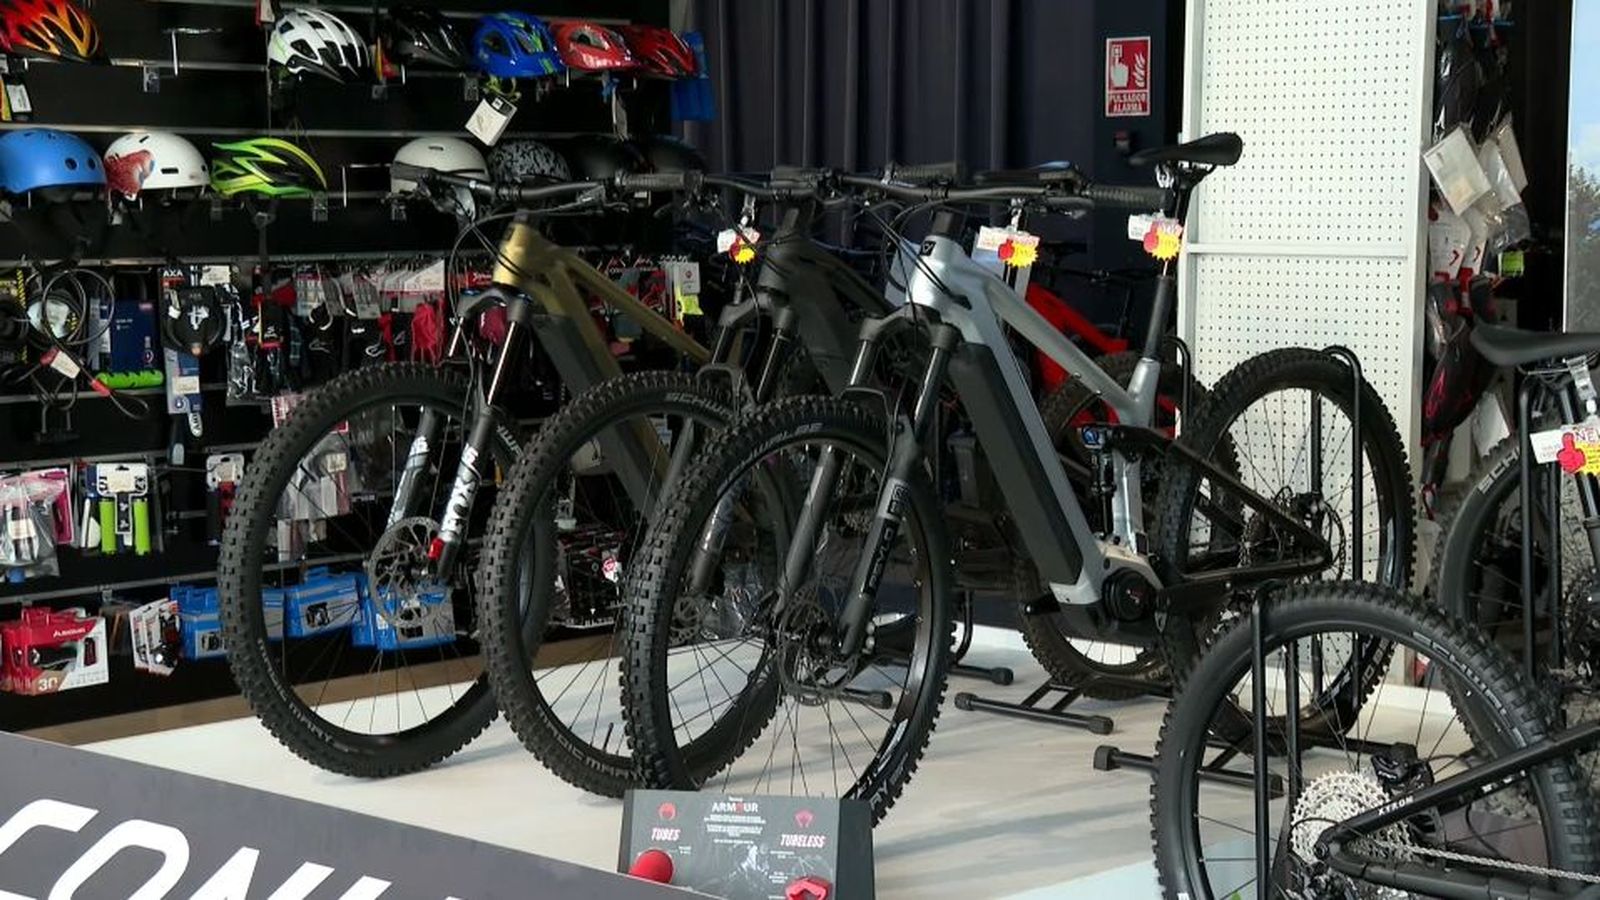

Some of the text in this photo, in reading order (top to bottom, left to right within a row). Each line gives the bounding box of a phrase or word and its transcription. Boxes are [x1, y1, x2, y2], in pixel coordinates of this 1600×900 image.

[1109, 93, 1146, 103] PULSADOR
[1113, 103, 1142, 111] ALARMA
[1477, 446, 1520, 494] SCH
[38, 676, 58, 691] 30
[712, 802, 758, 813] ARMOUR
[651, 827, 681, 842] TUBES
[780, 833, 826, 849] TUBELESS
